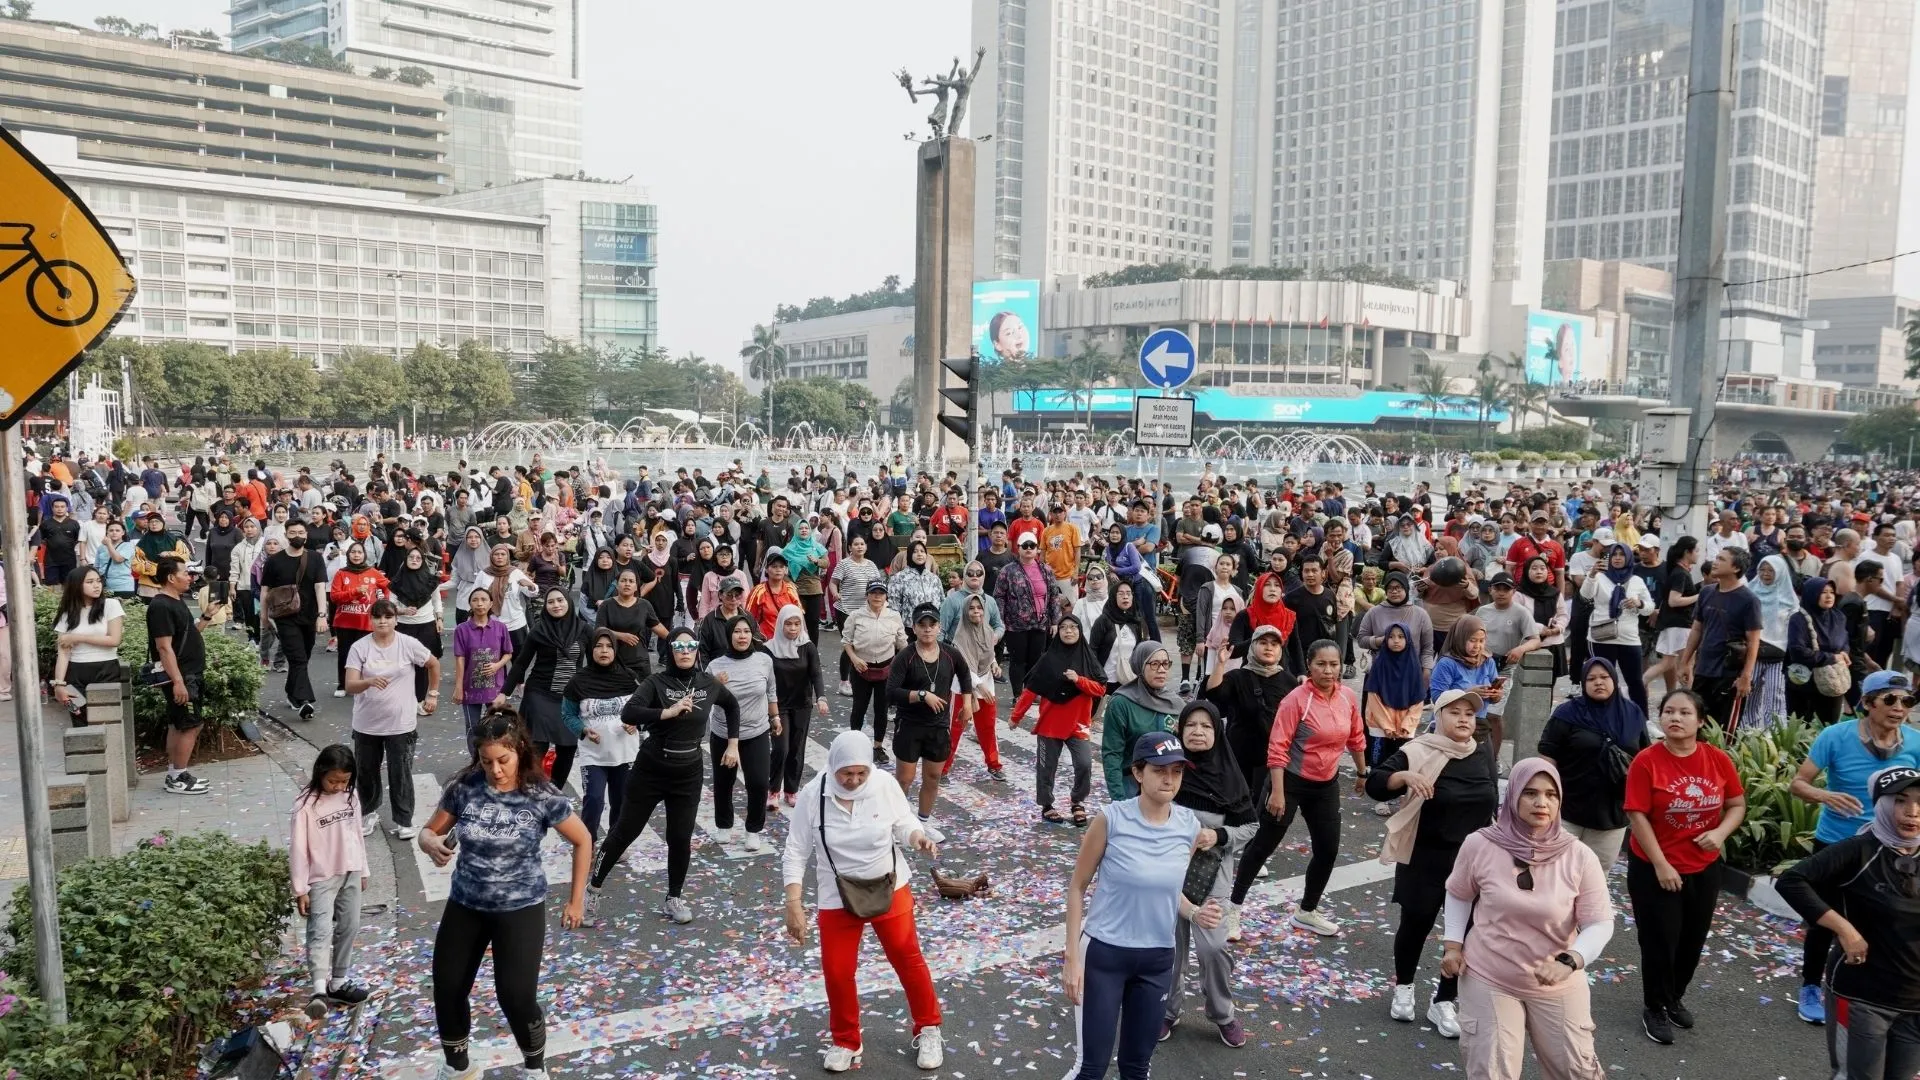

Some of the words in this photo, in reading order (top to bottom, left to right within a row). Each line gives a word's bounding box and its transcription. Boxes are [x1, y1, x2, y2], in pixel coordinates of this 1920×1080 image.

[597, 234, 636, 243] PLANET
[1154, 738, 1182, 756] FILA
[1666, 776, 1719, 793] CALIFORNIA
[1879, 769, 1920, 788] SPO
[1668, 798, 1696, 809] Stay
[1696, 794, 1721, 808] Wild
